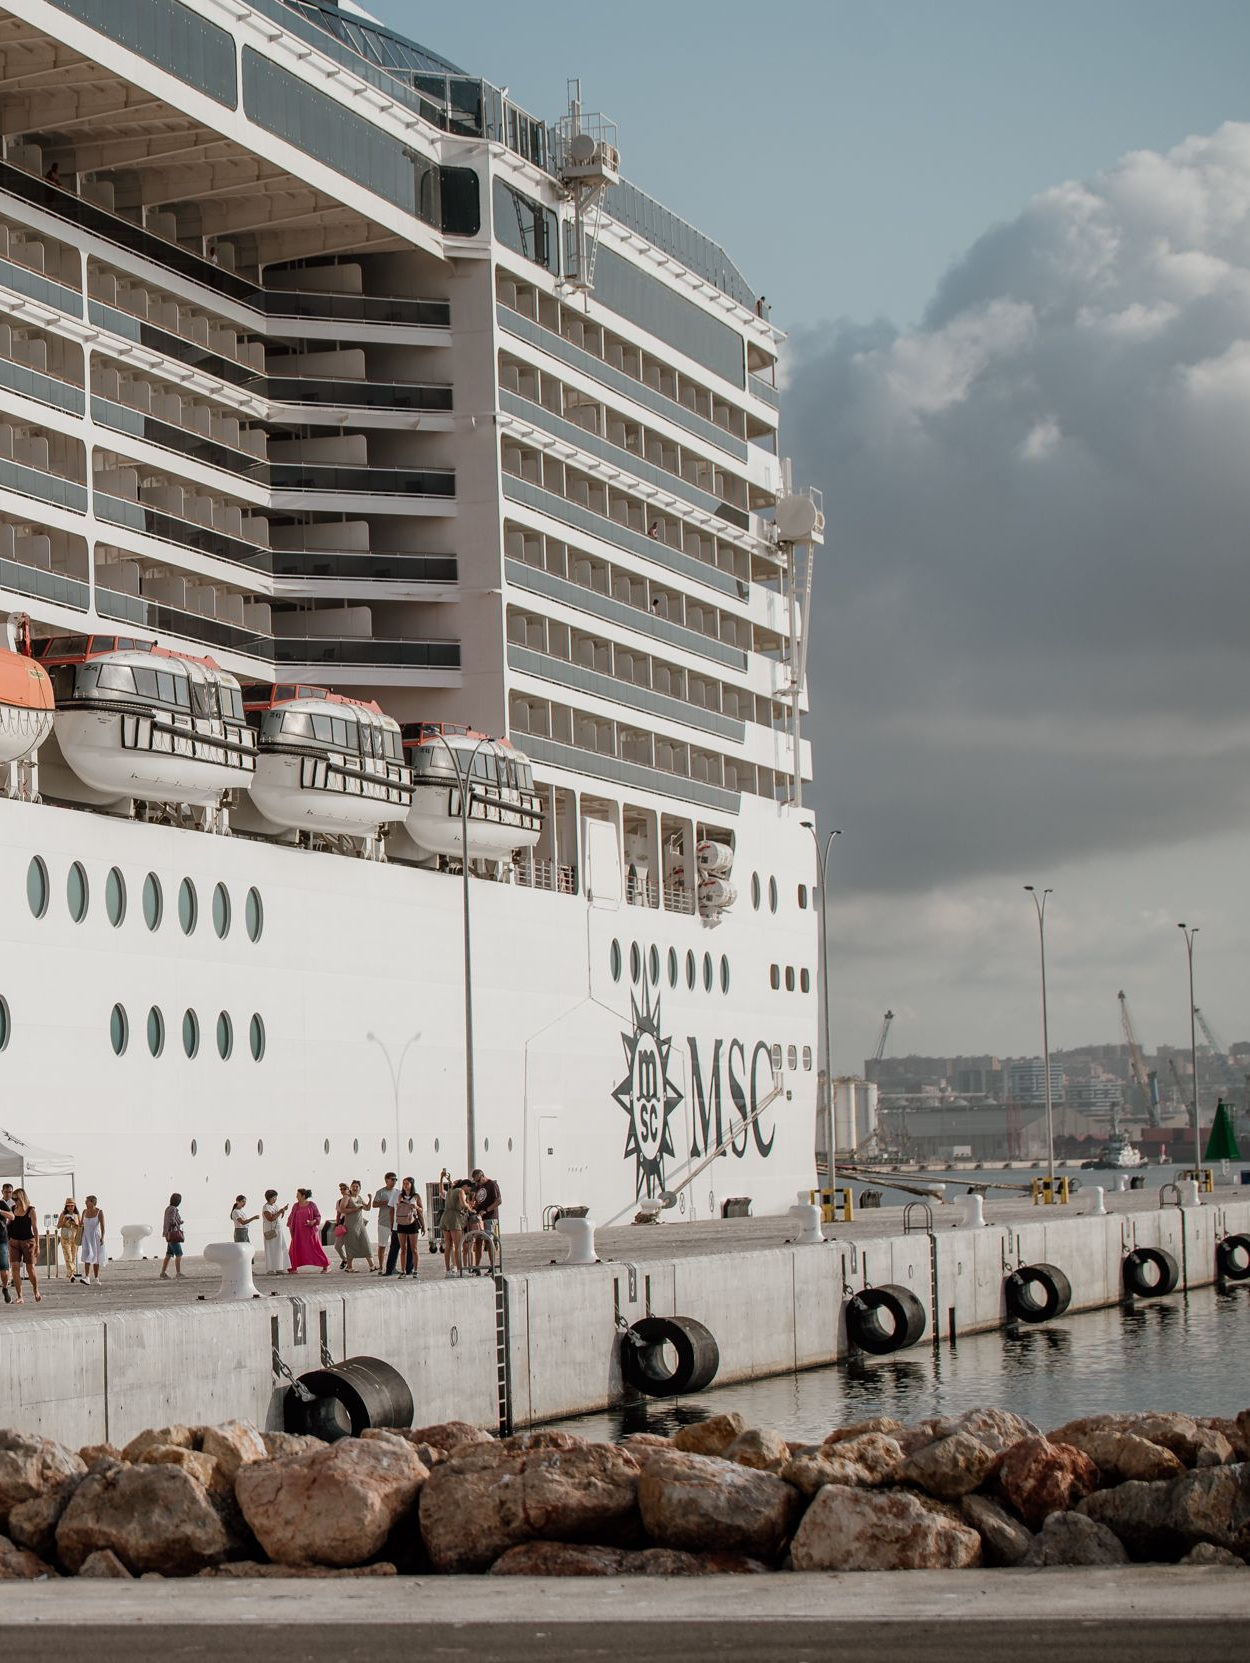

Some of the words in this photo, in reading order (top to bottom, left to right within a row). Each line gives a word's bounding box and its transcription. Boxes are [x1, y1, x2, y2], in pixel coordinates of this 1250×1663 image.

[84, 664, 98, 672] 24
[687, 1036, 776, 1159] MSC
[296, 1312, 302, 1337] 2
